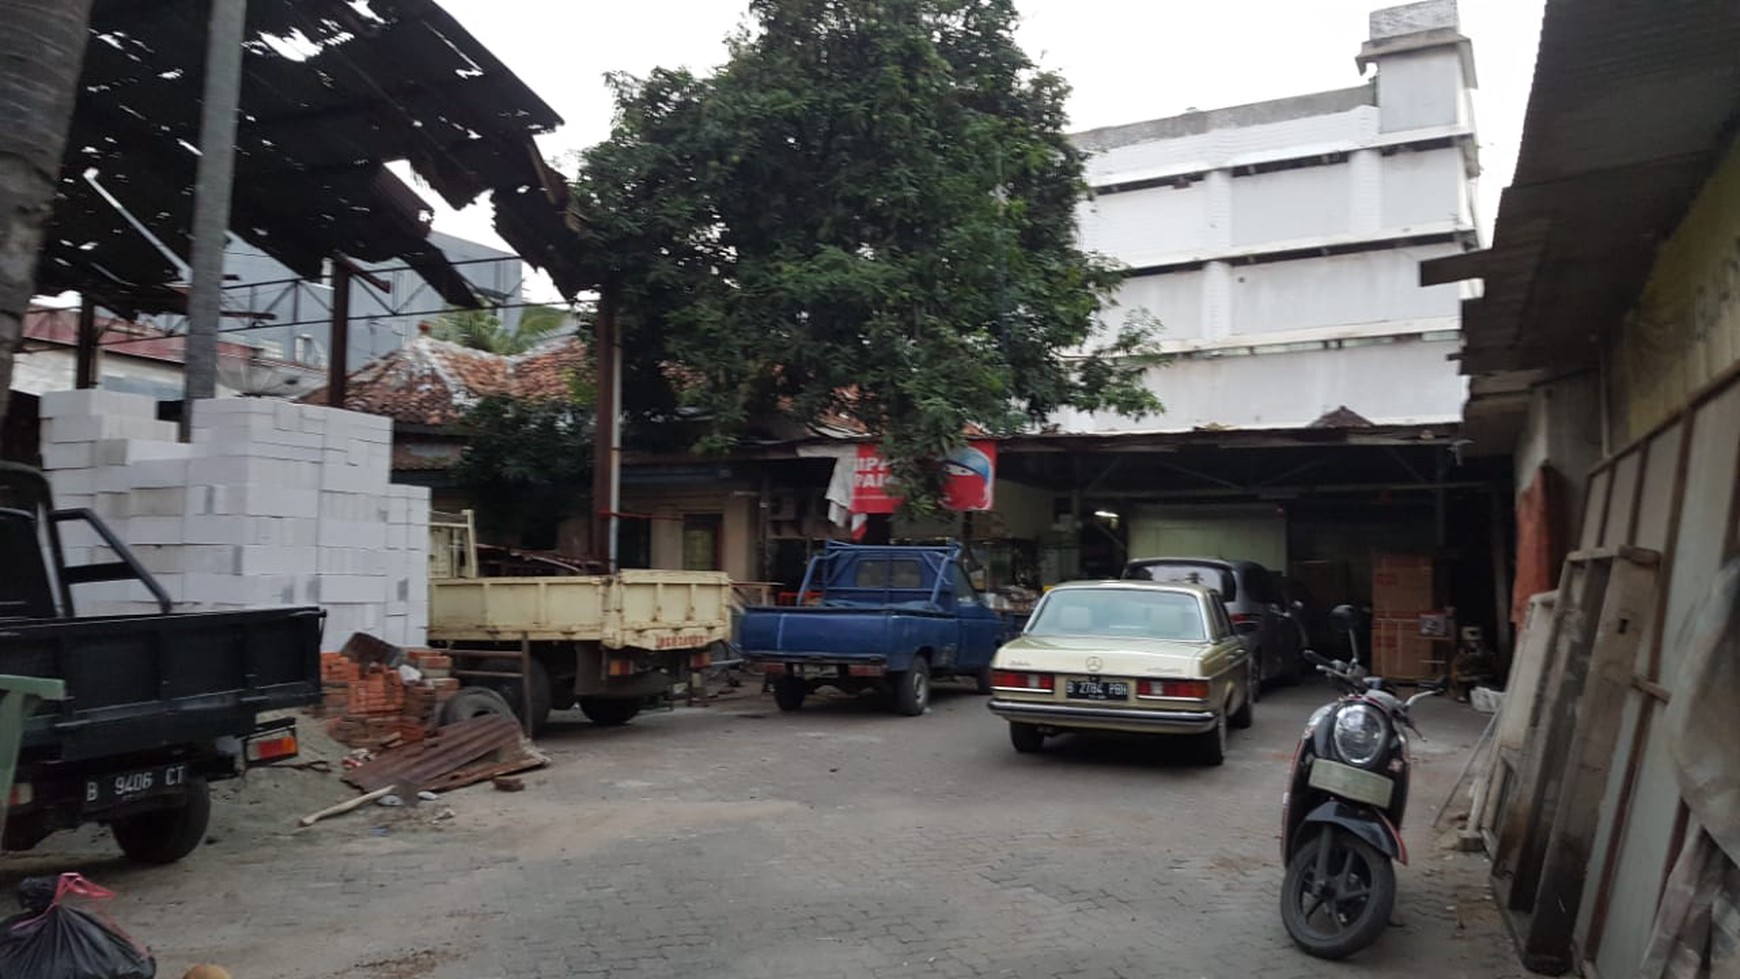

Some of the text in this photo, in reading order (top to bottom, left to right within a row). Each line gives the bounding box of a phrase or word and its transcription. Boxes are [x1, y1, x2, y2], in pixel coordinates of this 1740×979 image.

[86, 765, 185, 801] B 9406 CT
